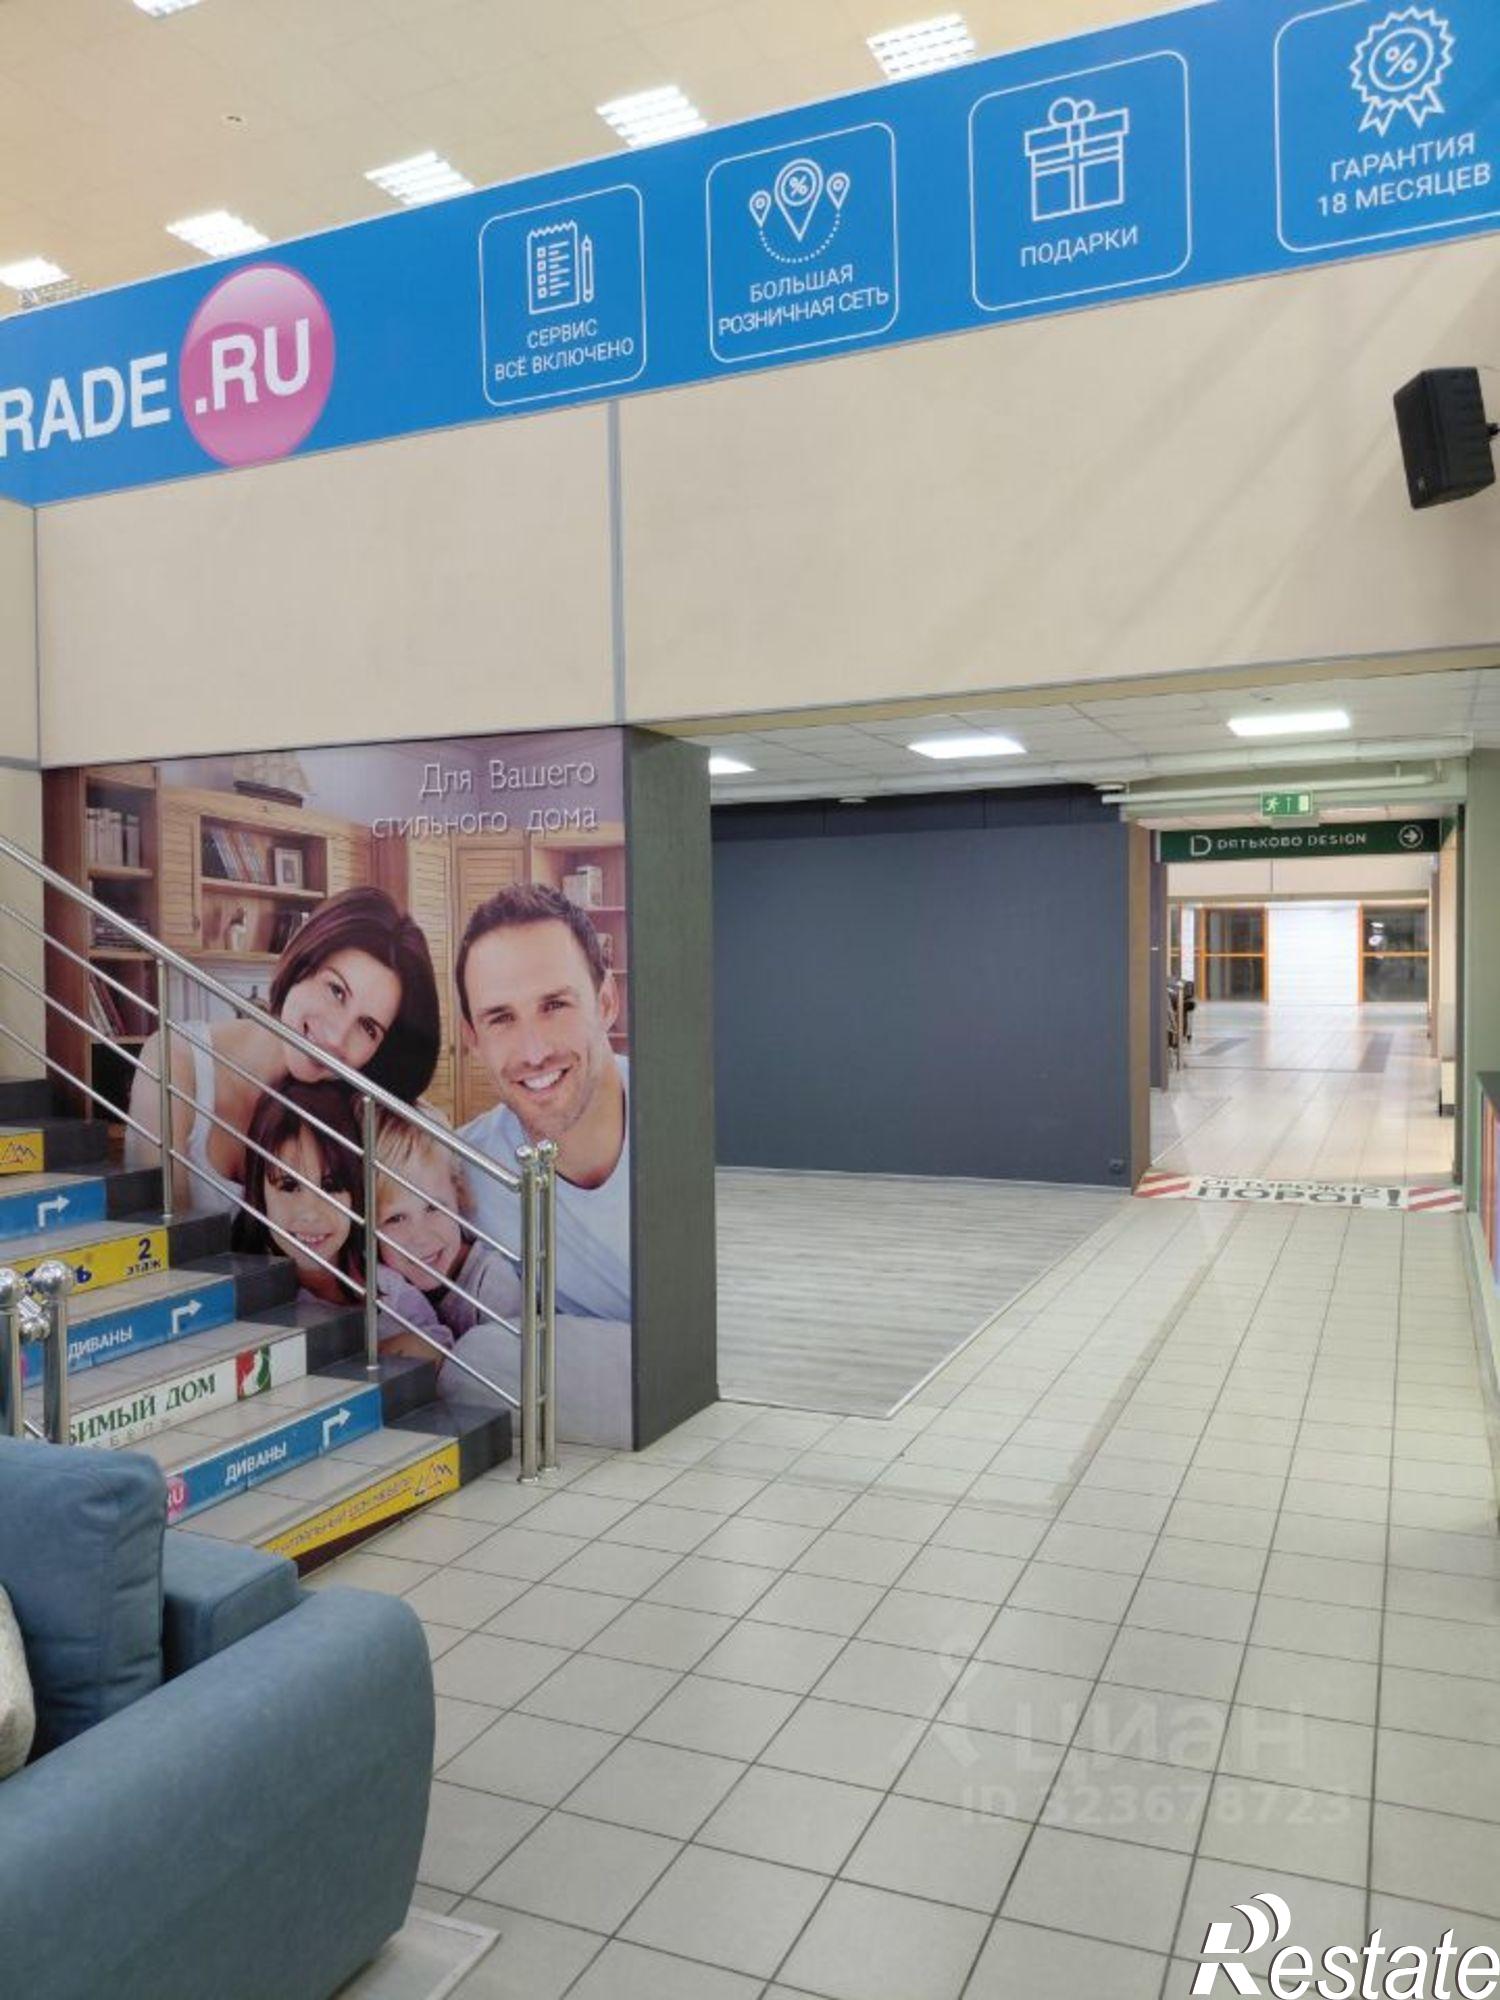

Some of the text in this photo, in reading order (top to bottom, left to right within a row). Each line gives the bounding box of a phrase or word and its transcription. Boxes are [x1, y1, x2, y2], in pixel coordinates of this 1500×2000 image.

[1330, 131, 1475, 183] ГАРАНТИЯ
[1317, 162, 1491, 217] 18 МЕСЯЦЕВ
[1020, 224, 1139, 268] ПОДАРКИ
[750, 263, 853, 303] БОЛЬШАЯ
[718, 286, 889, 336] РОЗНИЧНАЯ СЕТЬ
[527, 318, 599, 349] СЕРВИС
[195, 318, 311, 416] .RU
[495, 337, 635, 382] ВСЁ ВКЛЮЧЕНО
[419, 759, 597, 799] Для Вашего
[372, 806, 599, 839] стильного дома
[1307, 832, 1368, 847] DESIGN
[138, 1237, 152, 1262] 2
[68, 1325, 134, 1361] ДИВАНЫ
[166, 1373, 216, 1411] ДОМ
[224, 1440, 287, 1486] ДИВАНЫ
